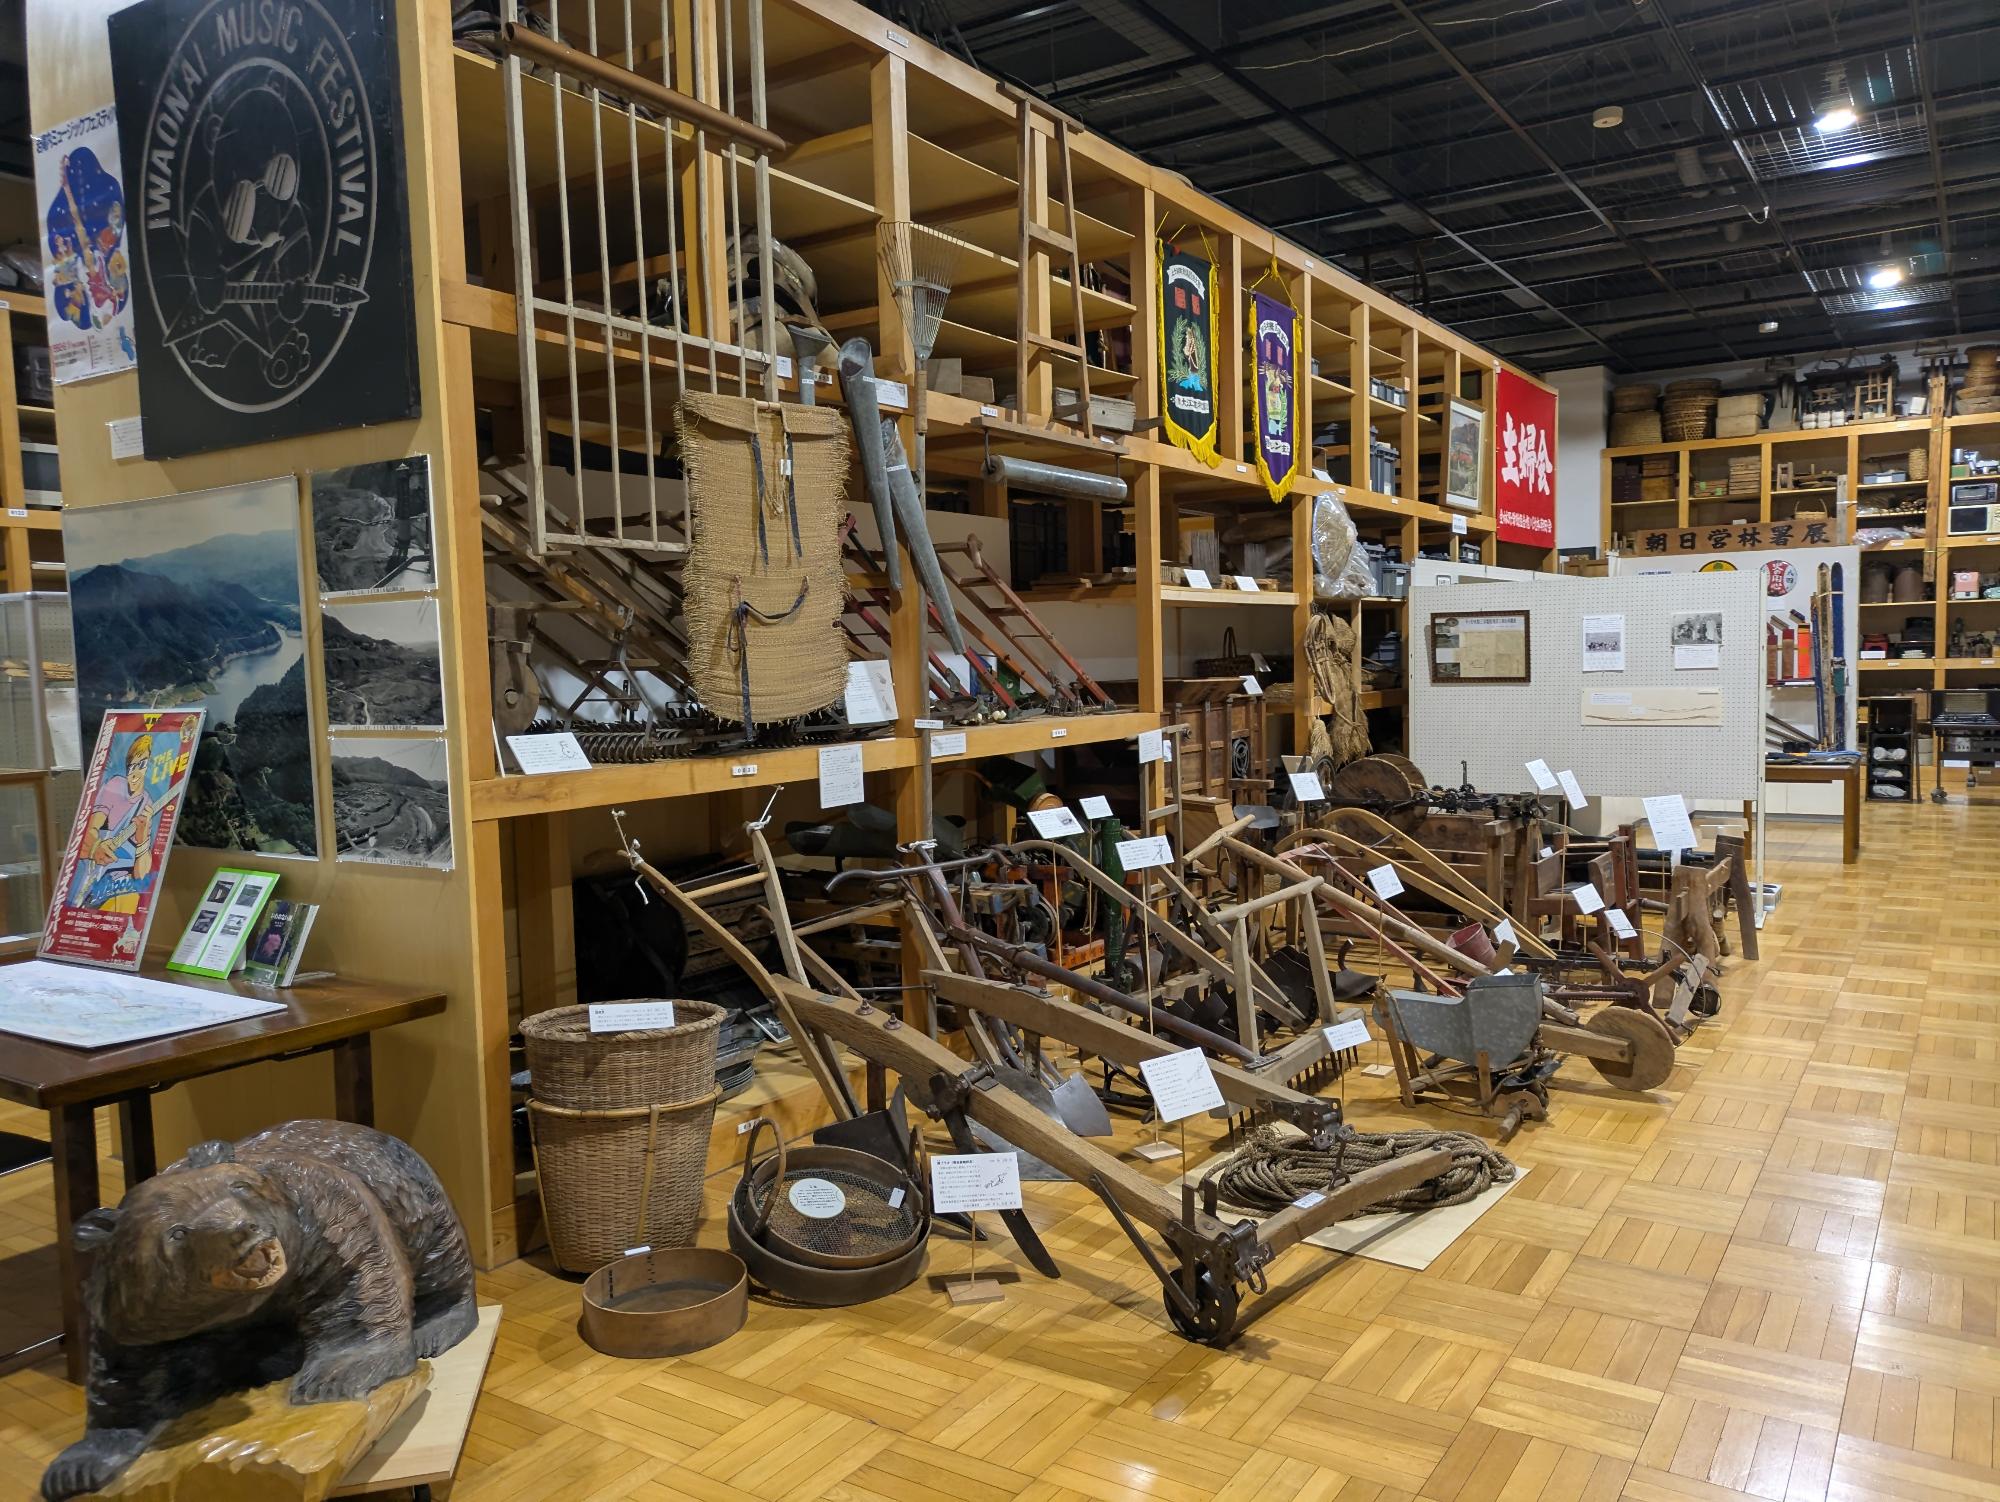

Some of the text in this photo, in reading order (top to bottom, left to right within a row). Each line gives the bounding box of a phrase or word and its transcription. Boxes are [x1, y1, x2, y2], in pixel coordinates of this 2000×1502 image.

[146, 0, 370, 257] IWAONAI MUSIC FESTIVAL
[1501, 411, 1553, 496] 主婦会
[1645, 522, 1831, 553] 朝日営林署展
[151, 752, 190, 785] LIVE
[153, 748, 174, 764] THE
